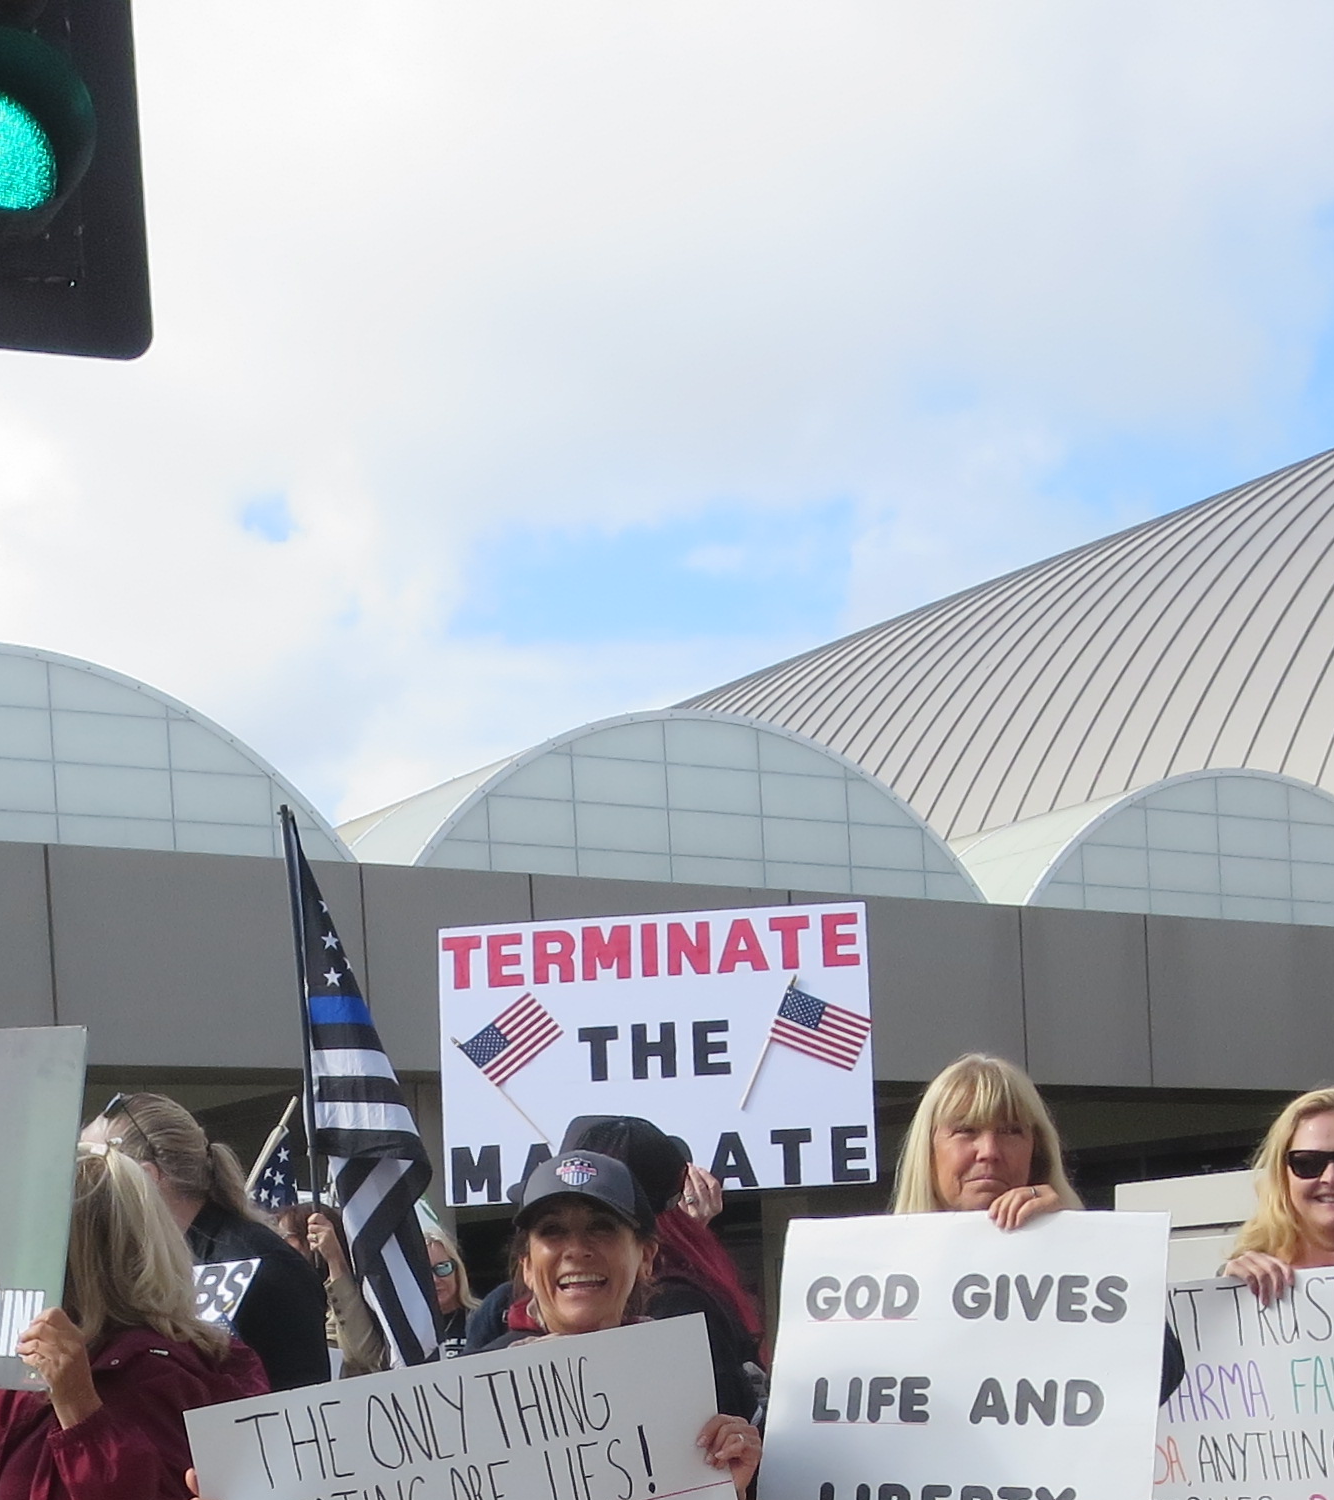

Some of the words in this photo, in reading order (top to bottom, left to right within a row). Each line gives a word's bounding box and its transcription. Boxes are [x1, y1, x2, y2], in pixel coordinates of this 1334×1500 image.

[441, 912, 861, 990] TERMINATE
[577, 1018, 732, 1082] THE
[450, 1125, 871, 1204] MATE
[805, 1272, 920, 1320] GOD
[952, 1272, 1130, 1324] GIVES
[234, 1400, 356, 1490] THE
[367, 1375, 470, 1470] ONLY
[473, 1356, 611, 1450] THING
[812, 1376, 931, 1424] LIFE
[968, 1377, 1105, 1427] AND
[1167, 1360, 1275, 1423] ARMA,
